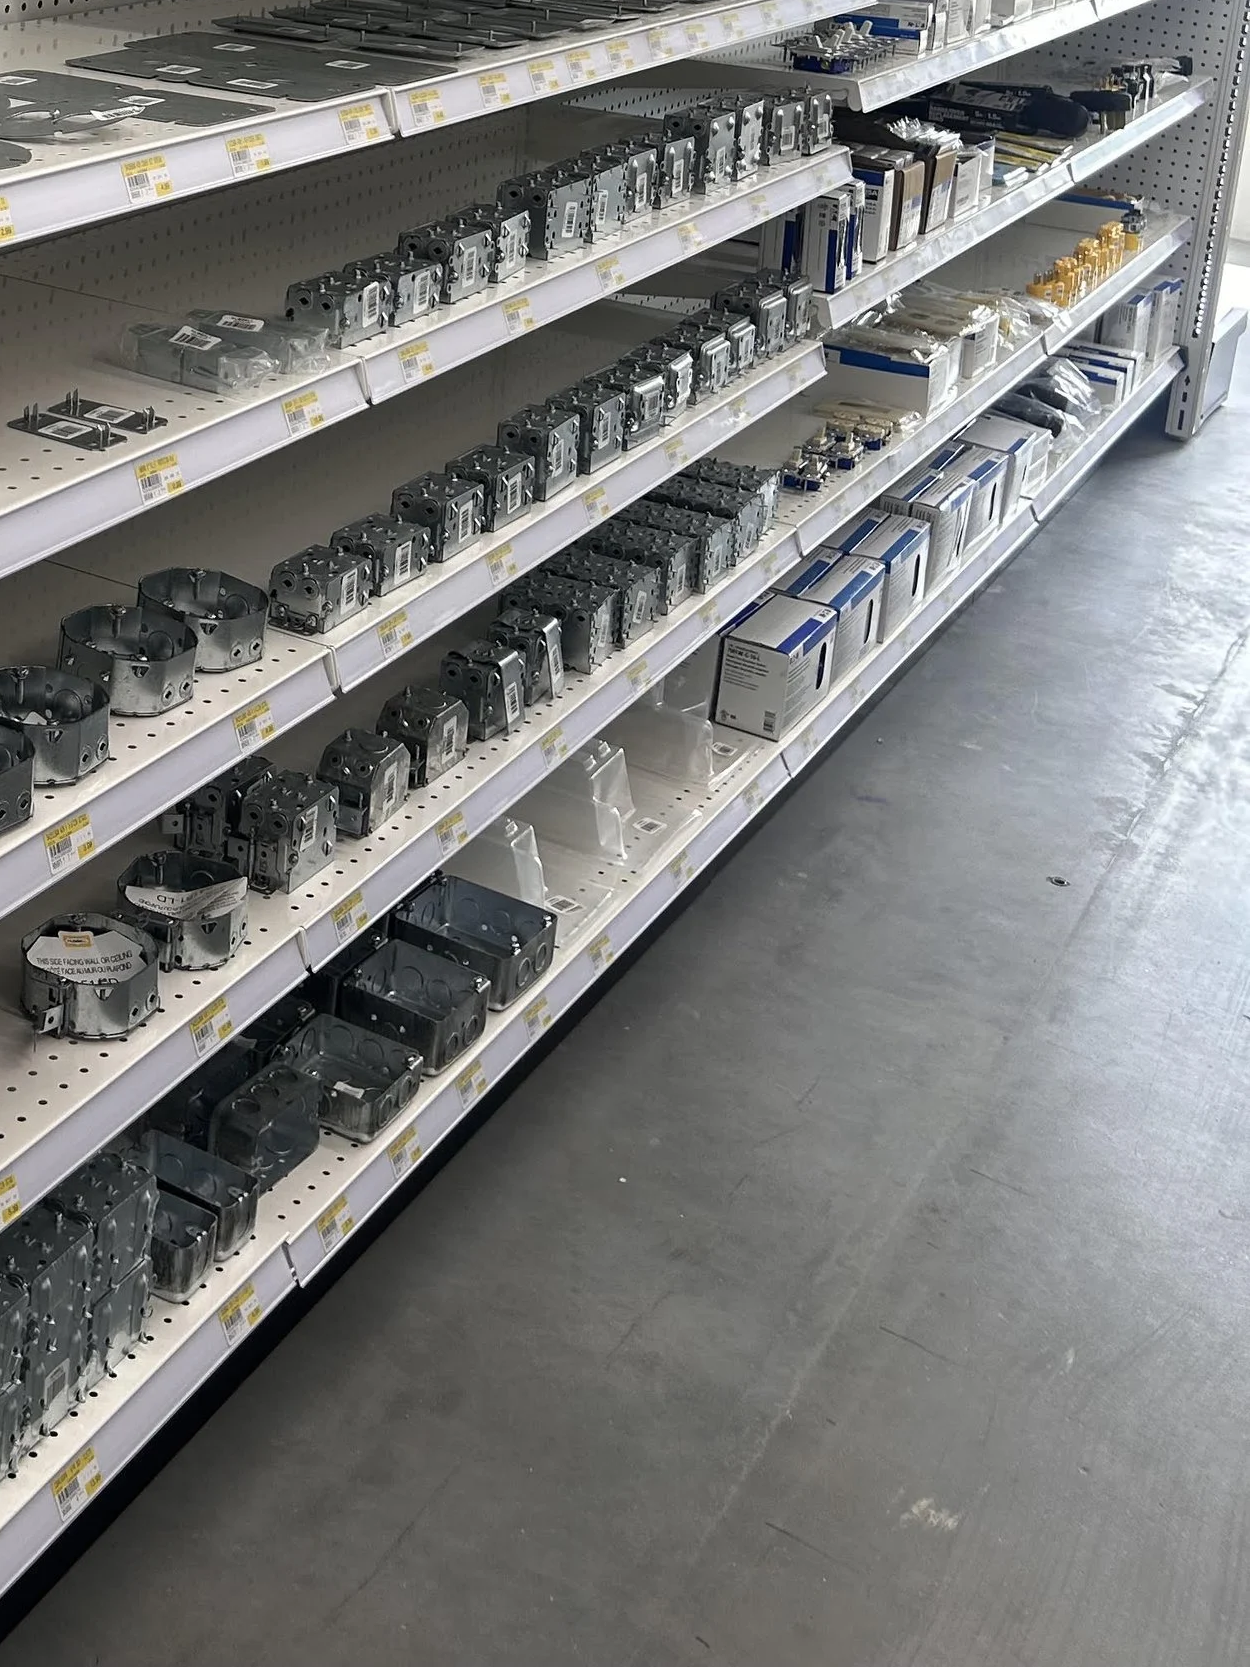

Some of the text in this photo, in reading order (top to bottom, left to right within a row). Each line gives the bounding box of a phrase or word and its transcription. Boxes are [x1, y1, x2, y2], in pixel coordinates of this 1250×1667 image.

[36, 957, 50, 965] THIS
[50, 958, 62, 966] SIDE
[63, 958, 84, 966] FACING
[84, 958, 100, 966] WALL
[100, 956, 111, 964] OR
